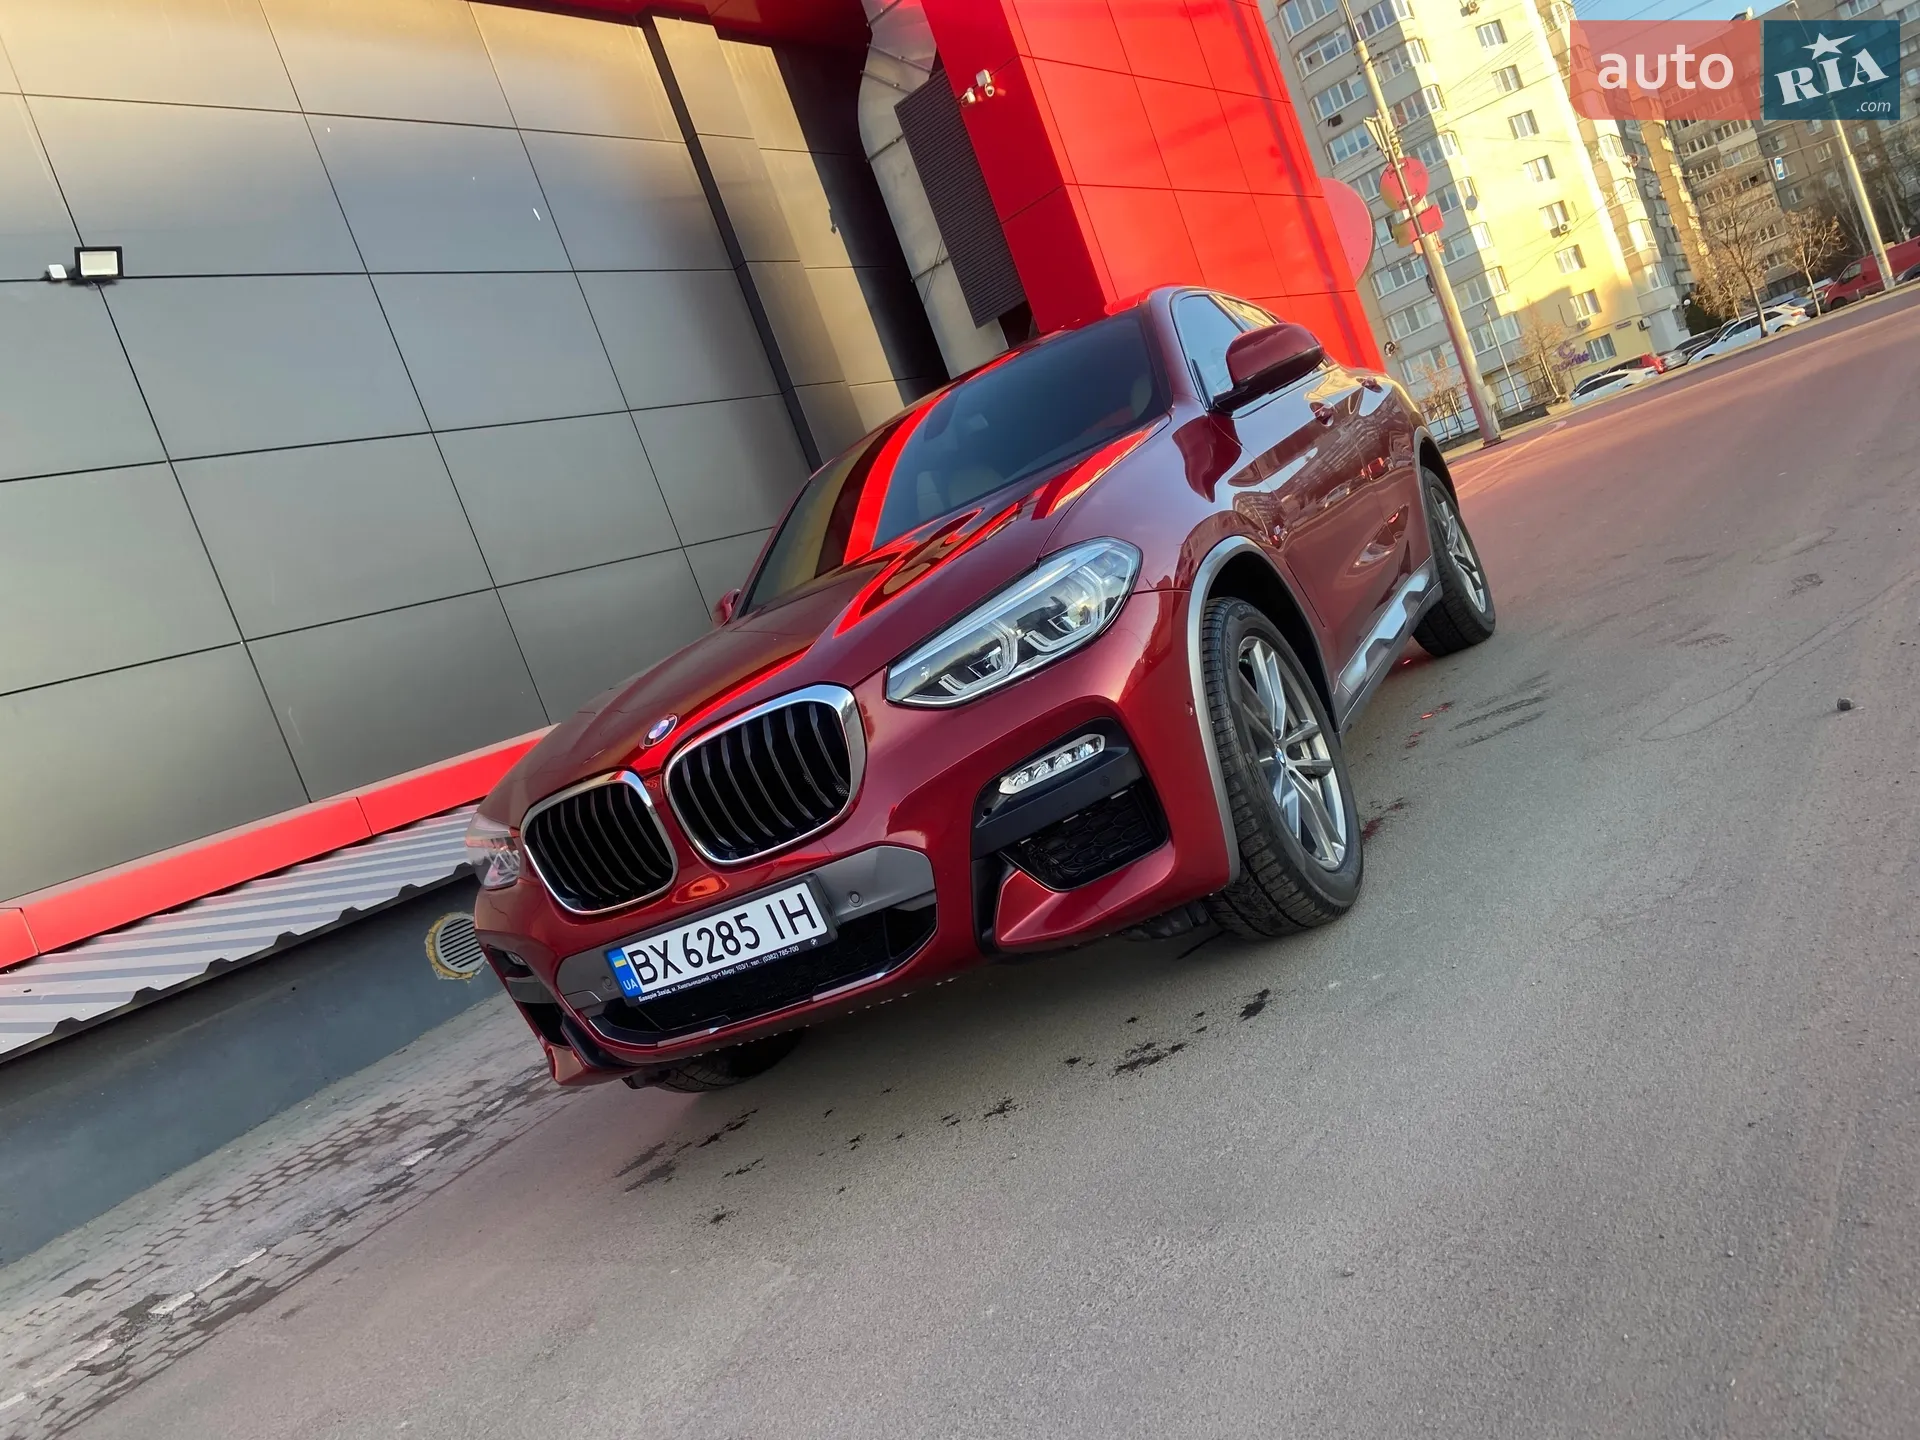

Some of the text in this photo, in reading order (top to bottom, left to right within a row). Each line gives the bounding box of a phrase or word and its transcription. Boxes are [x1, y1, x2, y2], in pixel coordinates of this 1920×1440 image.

[682, 912, 760, 969] 6285
[762, 951, 778, 963] (0382)
[778, 944, 800, 957] 785-700
[623, 978, 639, 991] UA
